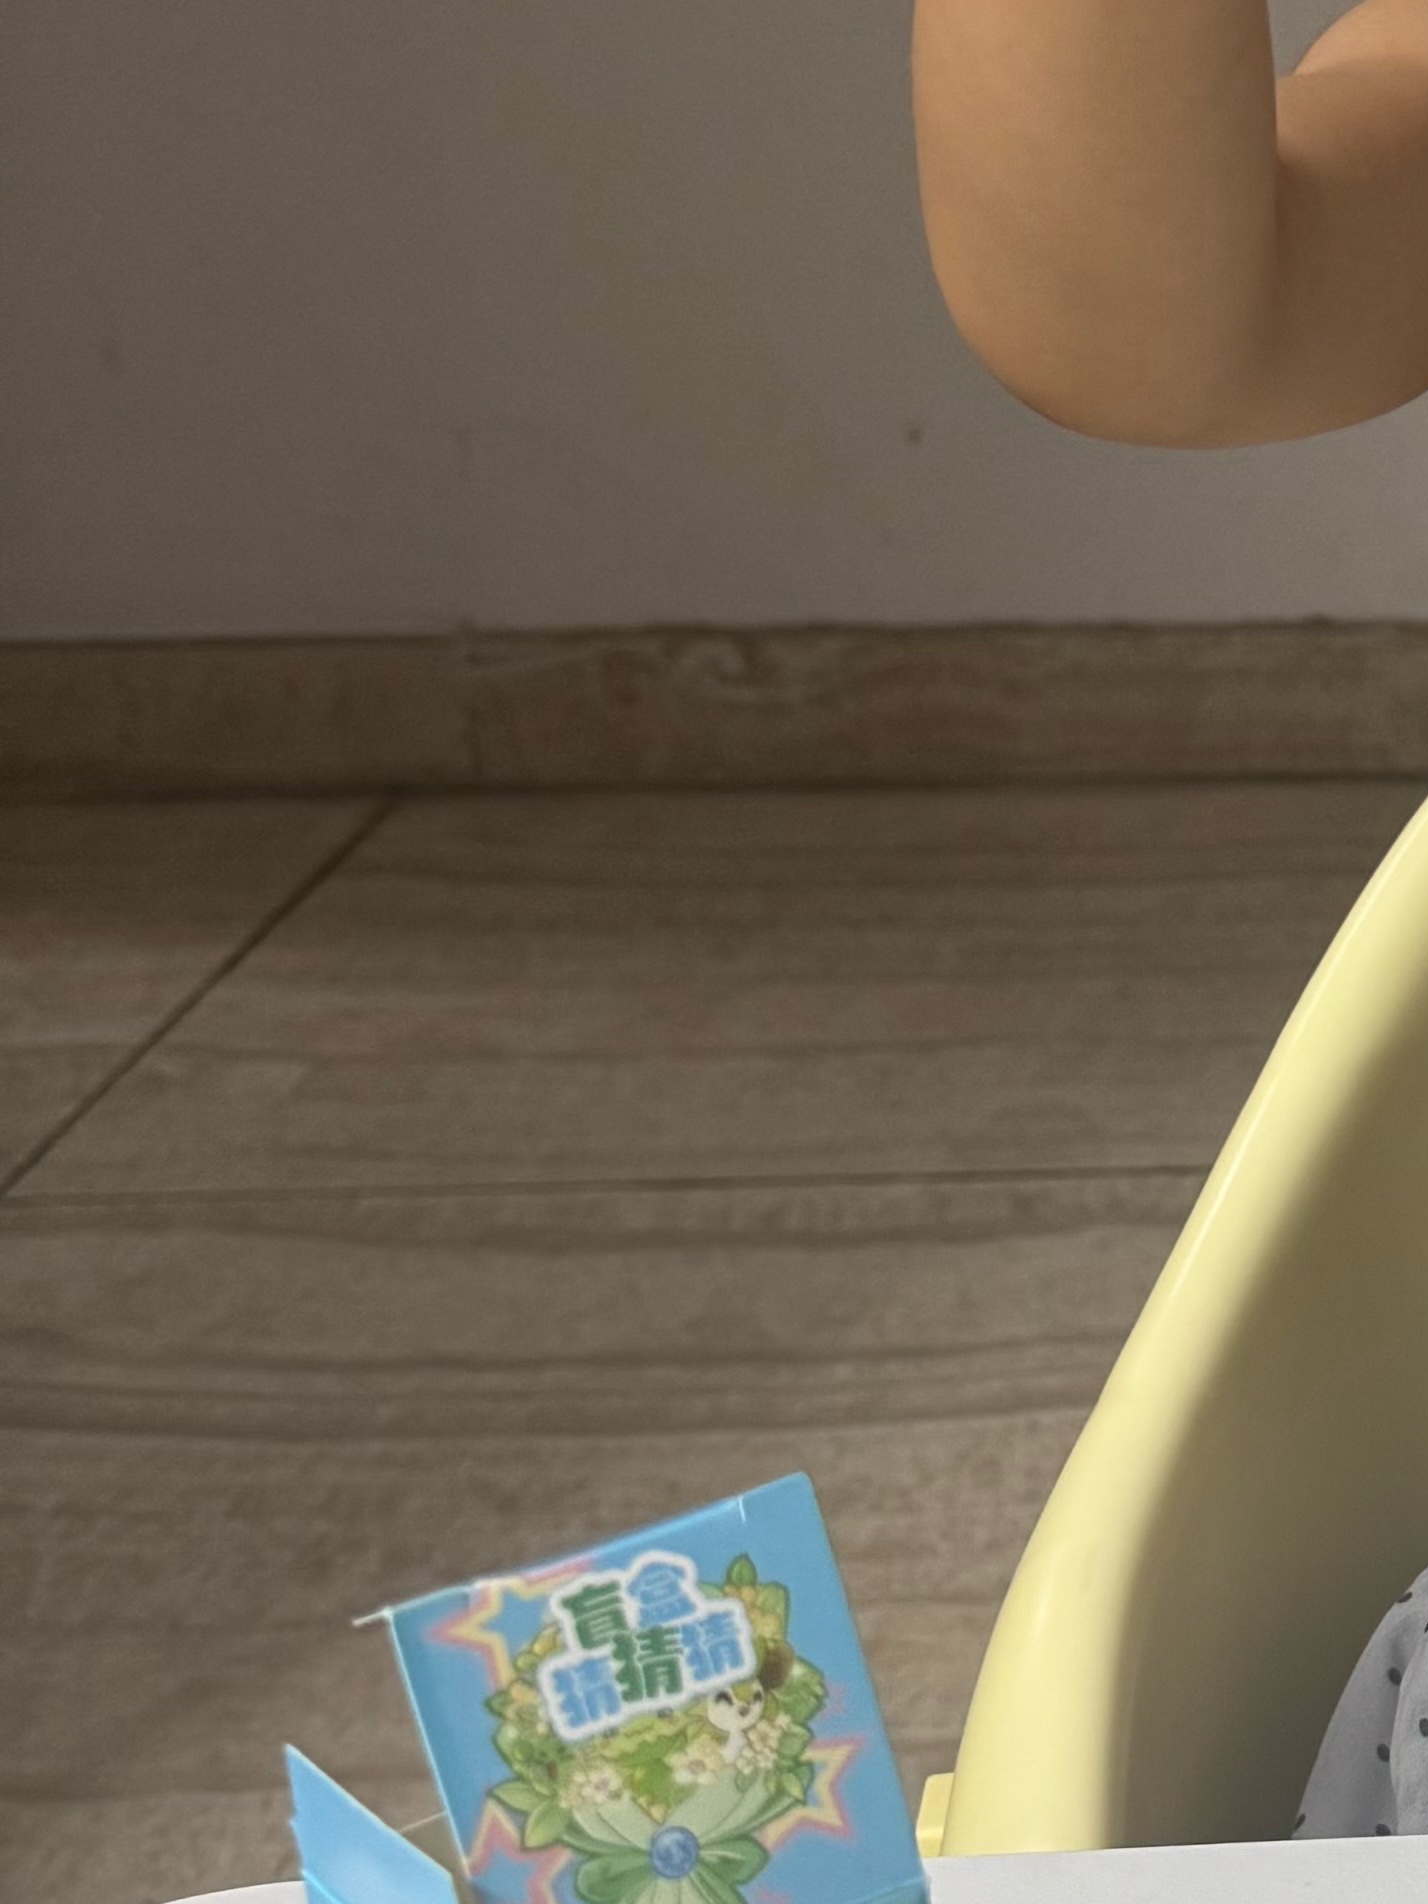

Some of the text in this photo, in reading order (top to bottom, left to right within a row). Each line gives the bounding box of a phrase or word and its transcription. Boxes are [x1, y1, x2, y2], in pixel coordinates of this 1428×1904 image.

[562, 1561, 698, 1650] 盲盒
[551, 1611, 746, 1729] 猜猜猜
